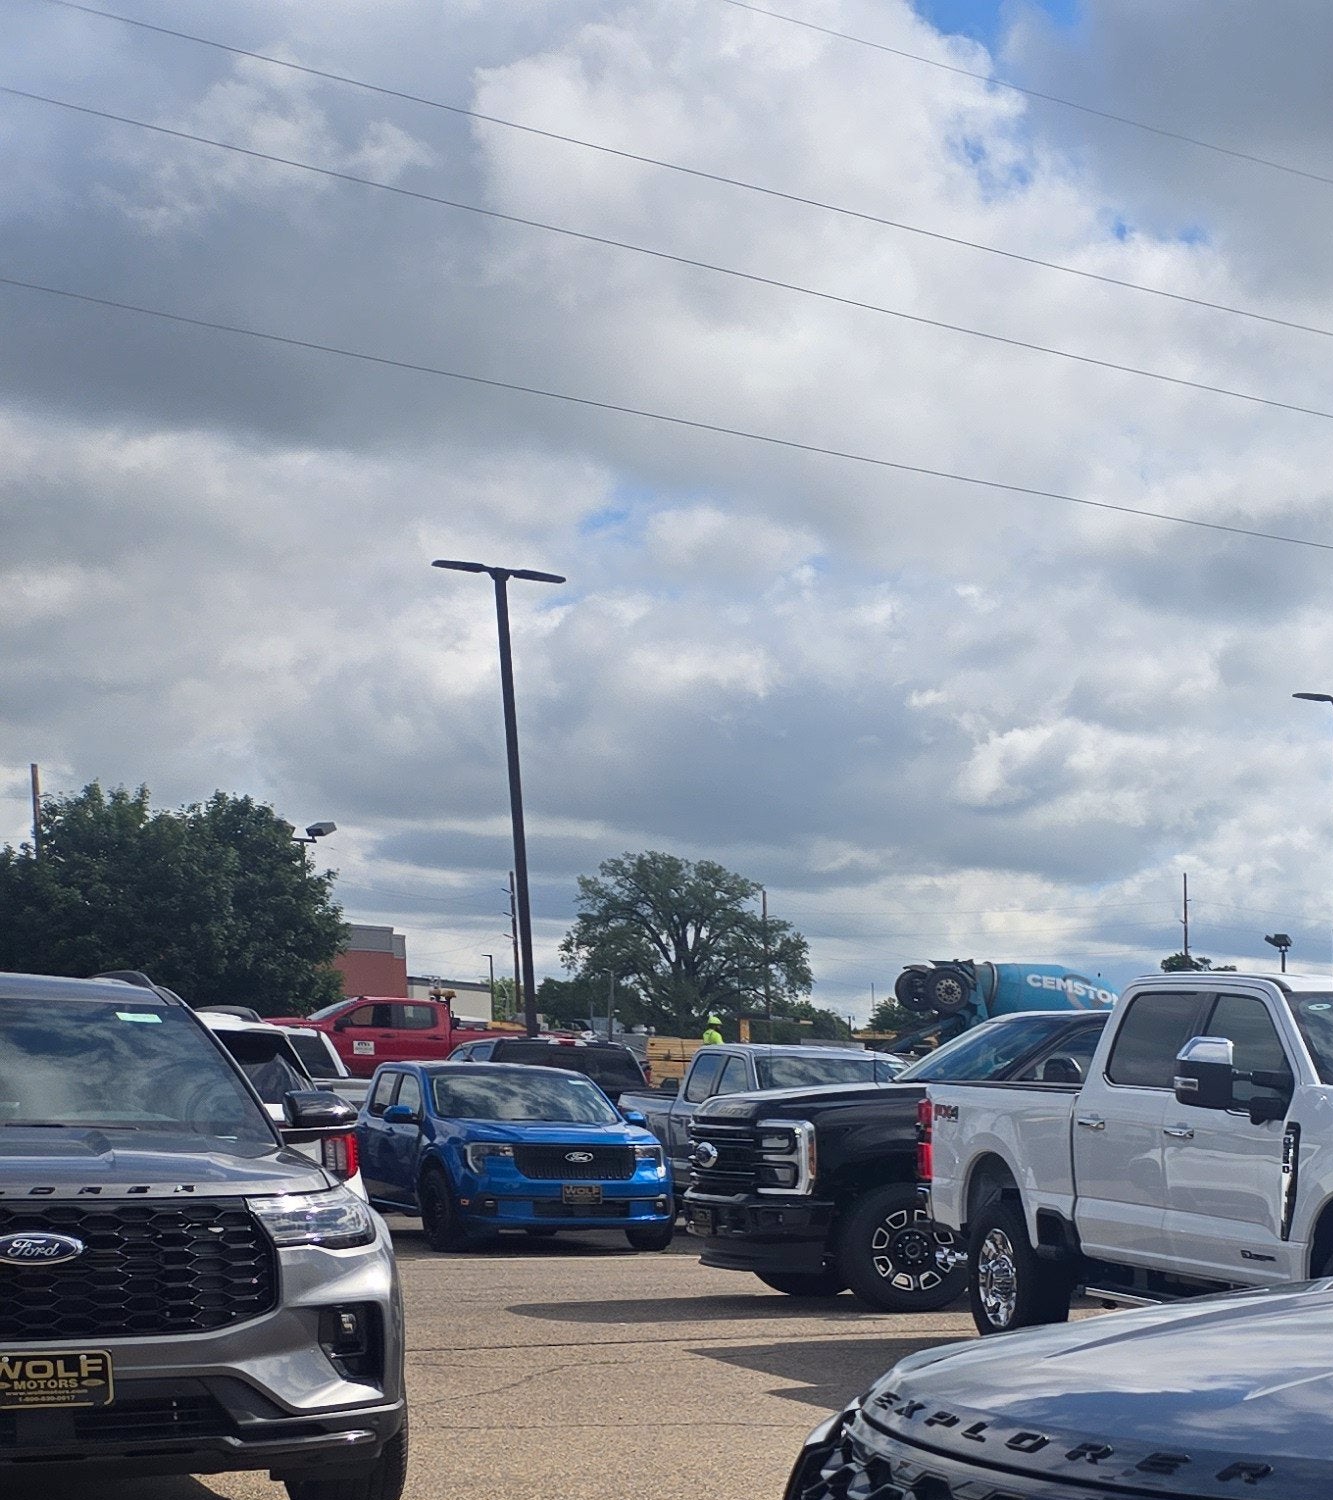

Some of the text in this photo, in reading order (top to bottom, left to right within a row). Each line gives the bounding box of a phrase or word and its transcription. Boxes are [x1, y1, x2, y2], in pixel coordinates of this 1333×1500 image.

[0, 1185, 196, 1195] ORER
[565, 1187, 599, 1195] WOLF
[7, 1238, 60, 1257] Ford
[13, 1378, 79, 1390] MOTORS
[873, 1391, 1274, 1484] EXPLORER
